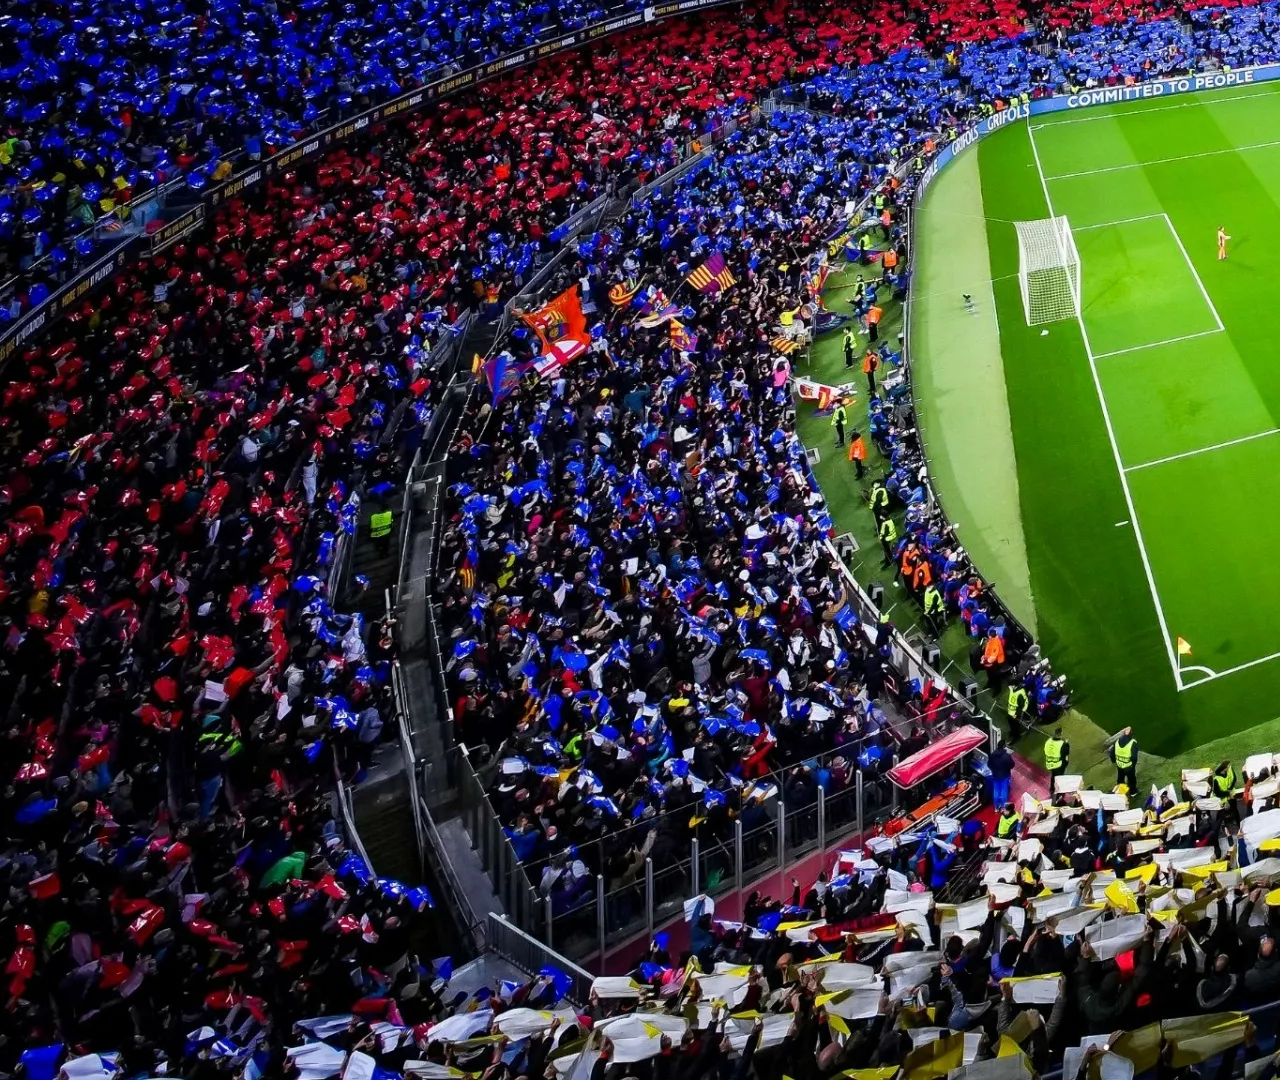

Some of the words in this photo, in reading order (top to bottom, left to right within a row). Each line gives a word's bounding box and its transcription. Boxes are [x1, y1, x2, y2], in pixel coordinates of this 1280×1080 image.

[1067, 84, 1163, 108] COMMITTED
[1168, 80, 1189, 93] TO
[1196, 71, 1253, 89] PEOPLE
[987, 103, 1030, 130] GRIFOLS
[951, 125, 979, 156] GRIFOLS
[224, 183, 234, 198] MÉS
[234, 179, 243, 194] QUE
[62, 288, 76, 307] MORE
[76, 278, 90, 297] THAN
[95, 261, 114, 284] PLAYERS
